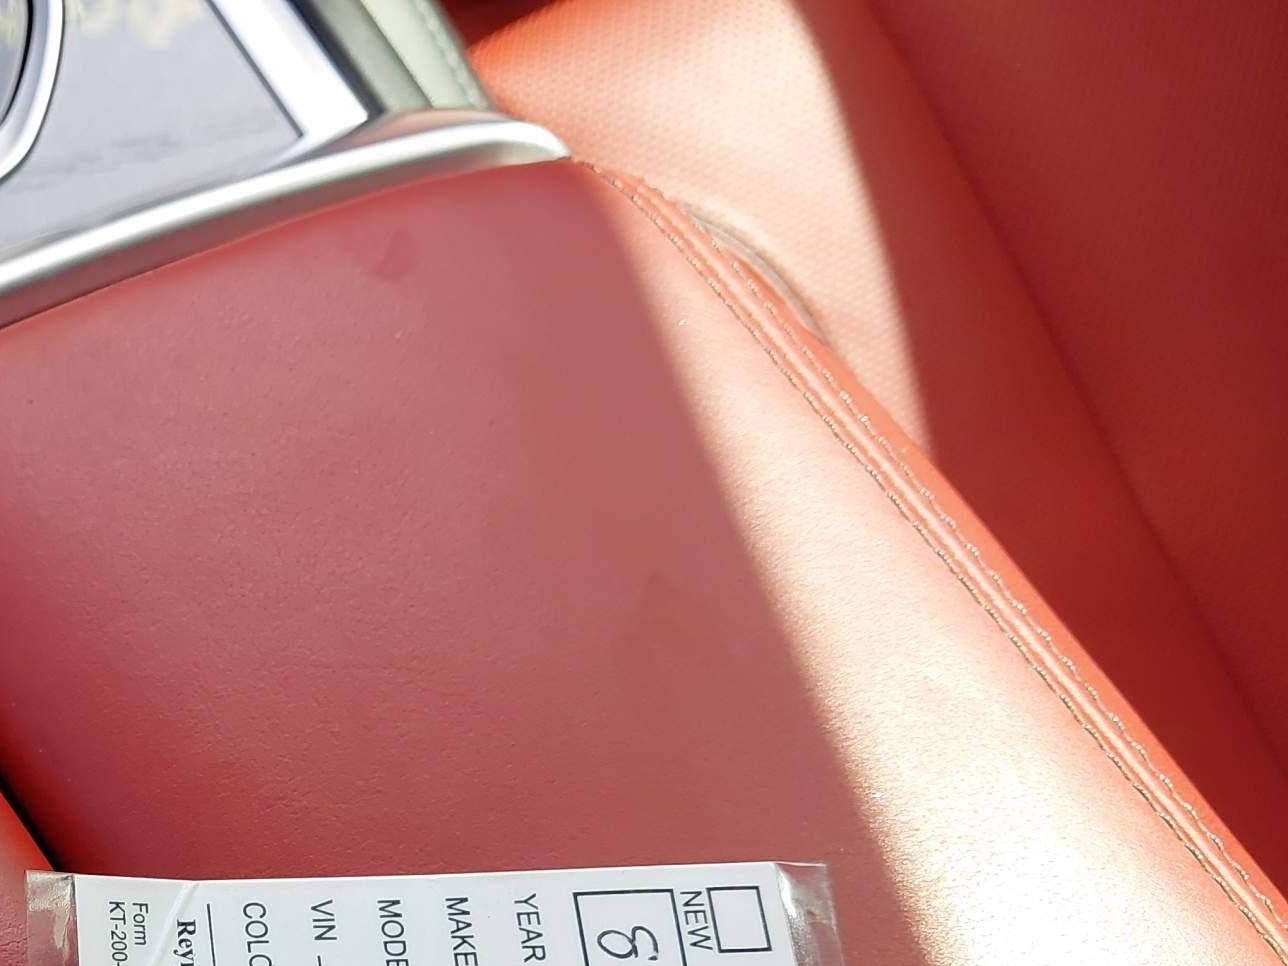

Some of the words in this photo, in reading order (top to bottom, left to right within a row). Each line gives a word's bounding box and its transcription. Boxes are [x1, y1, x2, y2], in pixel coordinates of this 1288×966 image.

[132, 902, 149, 946] Form
[310, 899, 338, 941] VIN
[513, 893, 546, 963] YEAR
[679, 890, 713, 951] NEW
